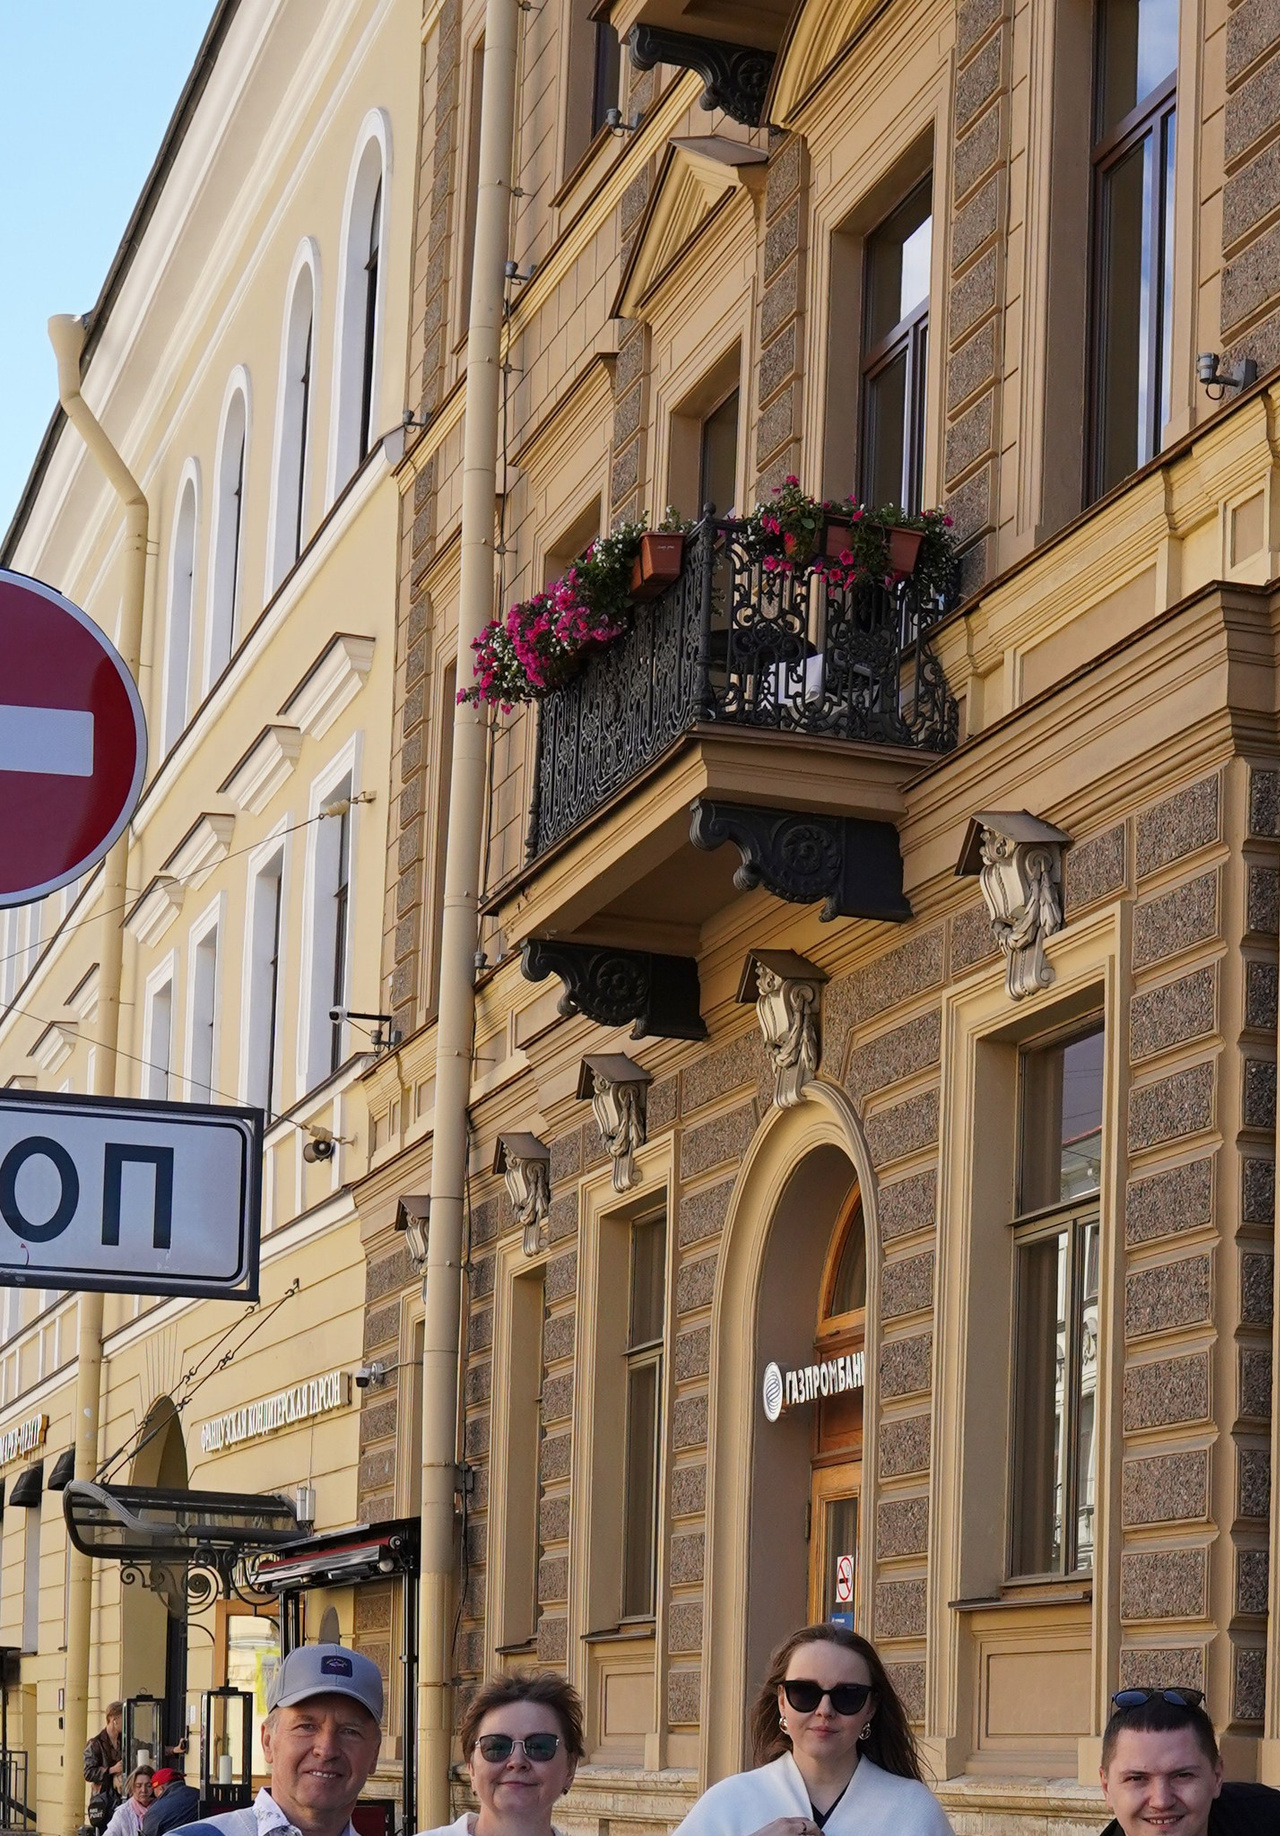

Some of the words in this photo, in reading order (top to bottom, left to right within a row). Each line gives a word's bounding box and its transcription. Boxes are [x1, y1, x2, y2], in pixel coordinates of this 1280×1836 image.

[201, 1407, 248, 1453] ФРАНЦУЗСКАЯ
[248, 1384, 308, 1437] КОНДИТЕРСКАЯ
[309, 1371, 342, 1415] ГАРСОН
